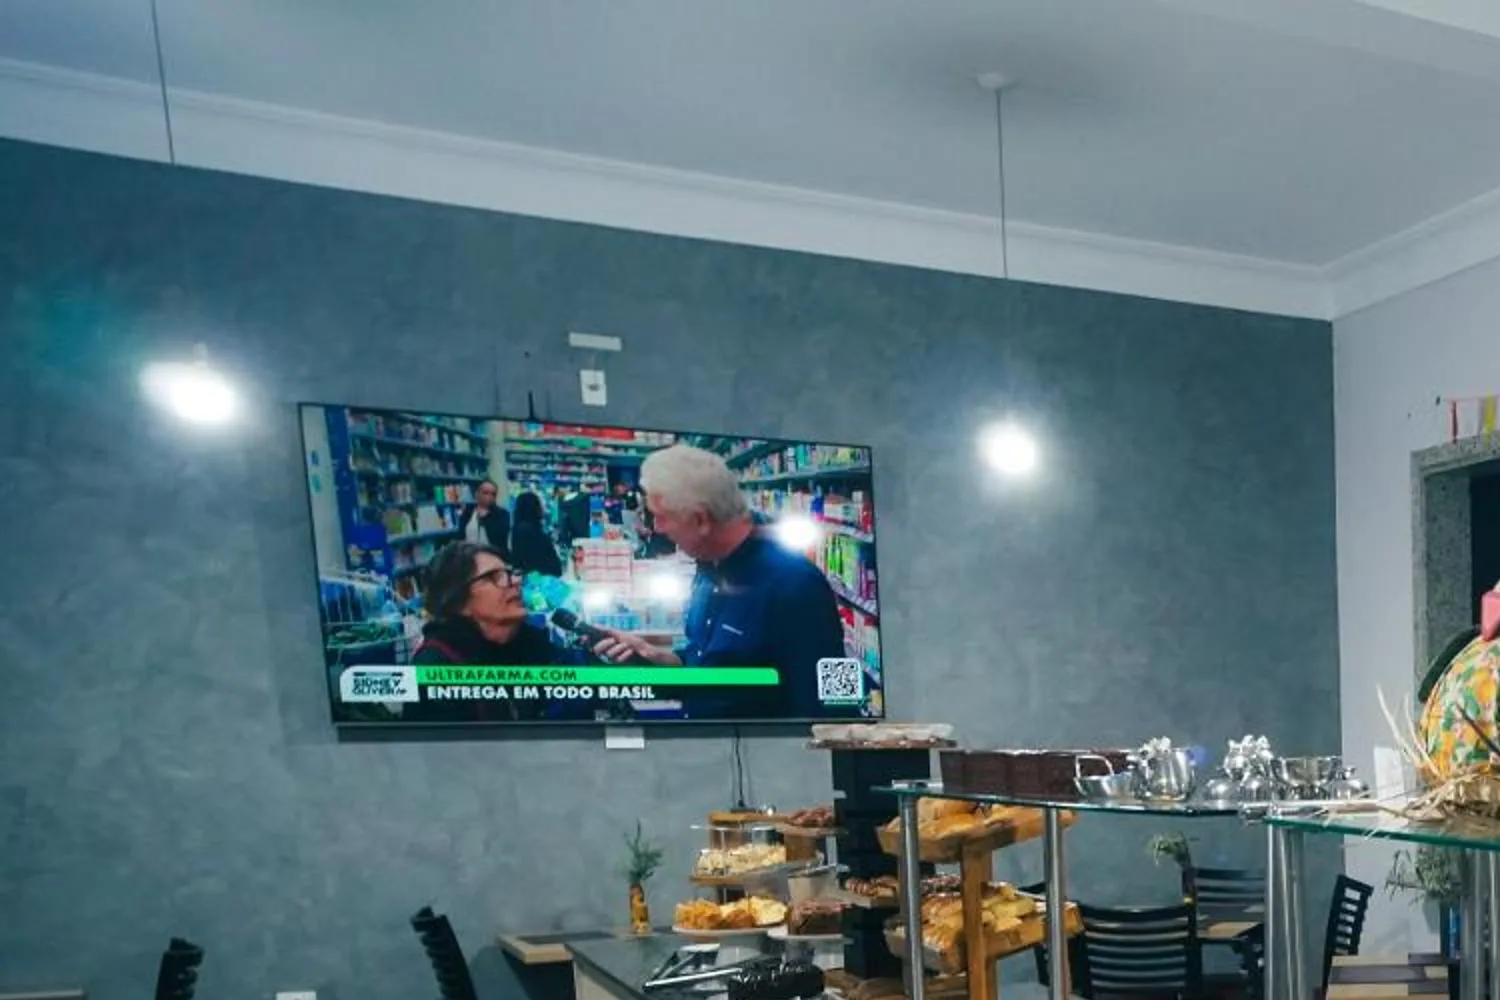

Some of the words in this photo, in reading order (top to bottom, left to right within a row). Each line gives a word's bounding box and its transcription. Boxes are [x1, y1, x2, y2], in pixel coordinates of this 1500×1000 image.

[425, 668, 577, 682] ULTRAFARMA.COM
[427, 685, 508, 699] ENTREGA
[513, 686, 539, 699] EM
[544, 686, 594, 699] TODO
[599, 686, 656, 700] BRASIL
